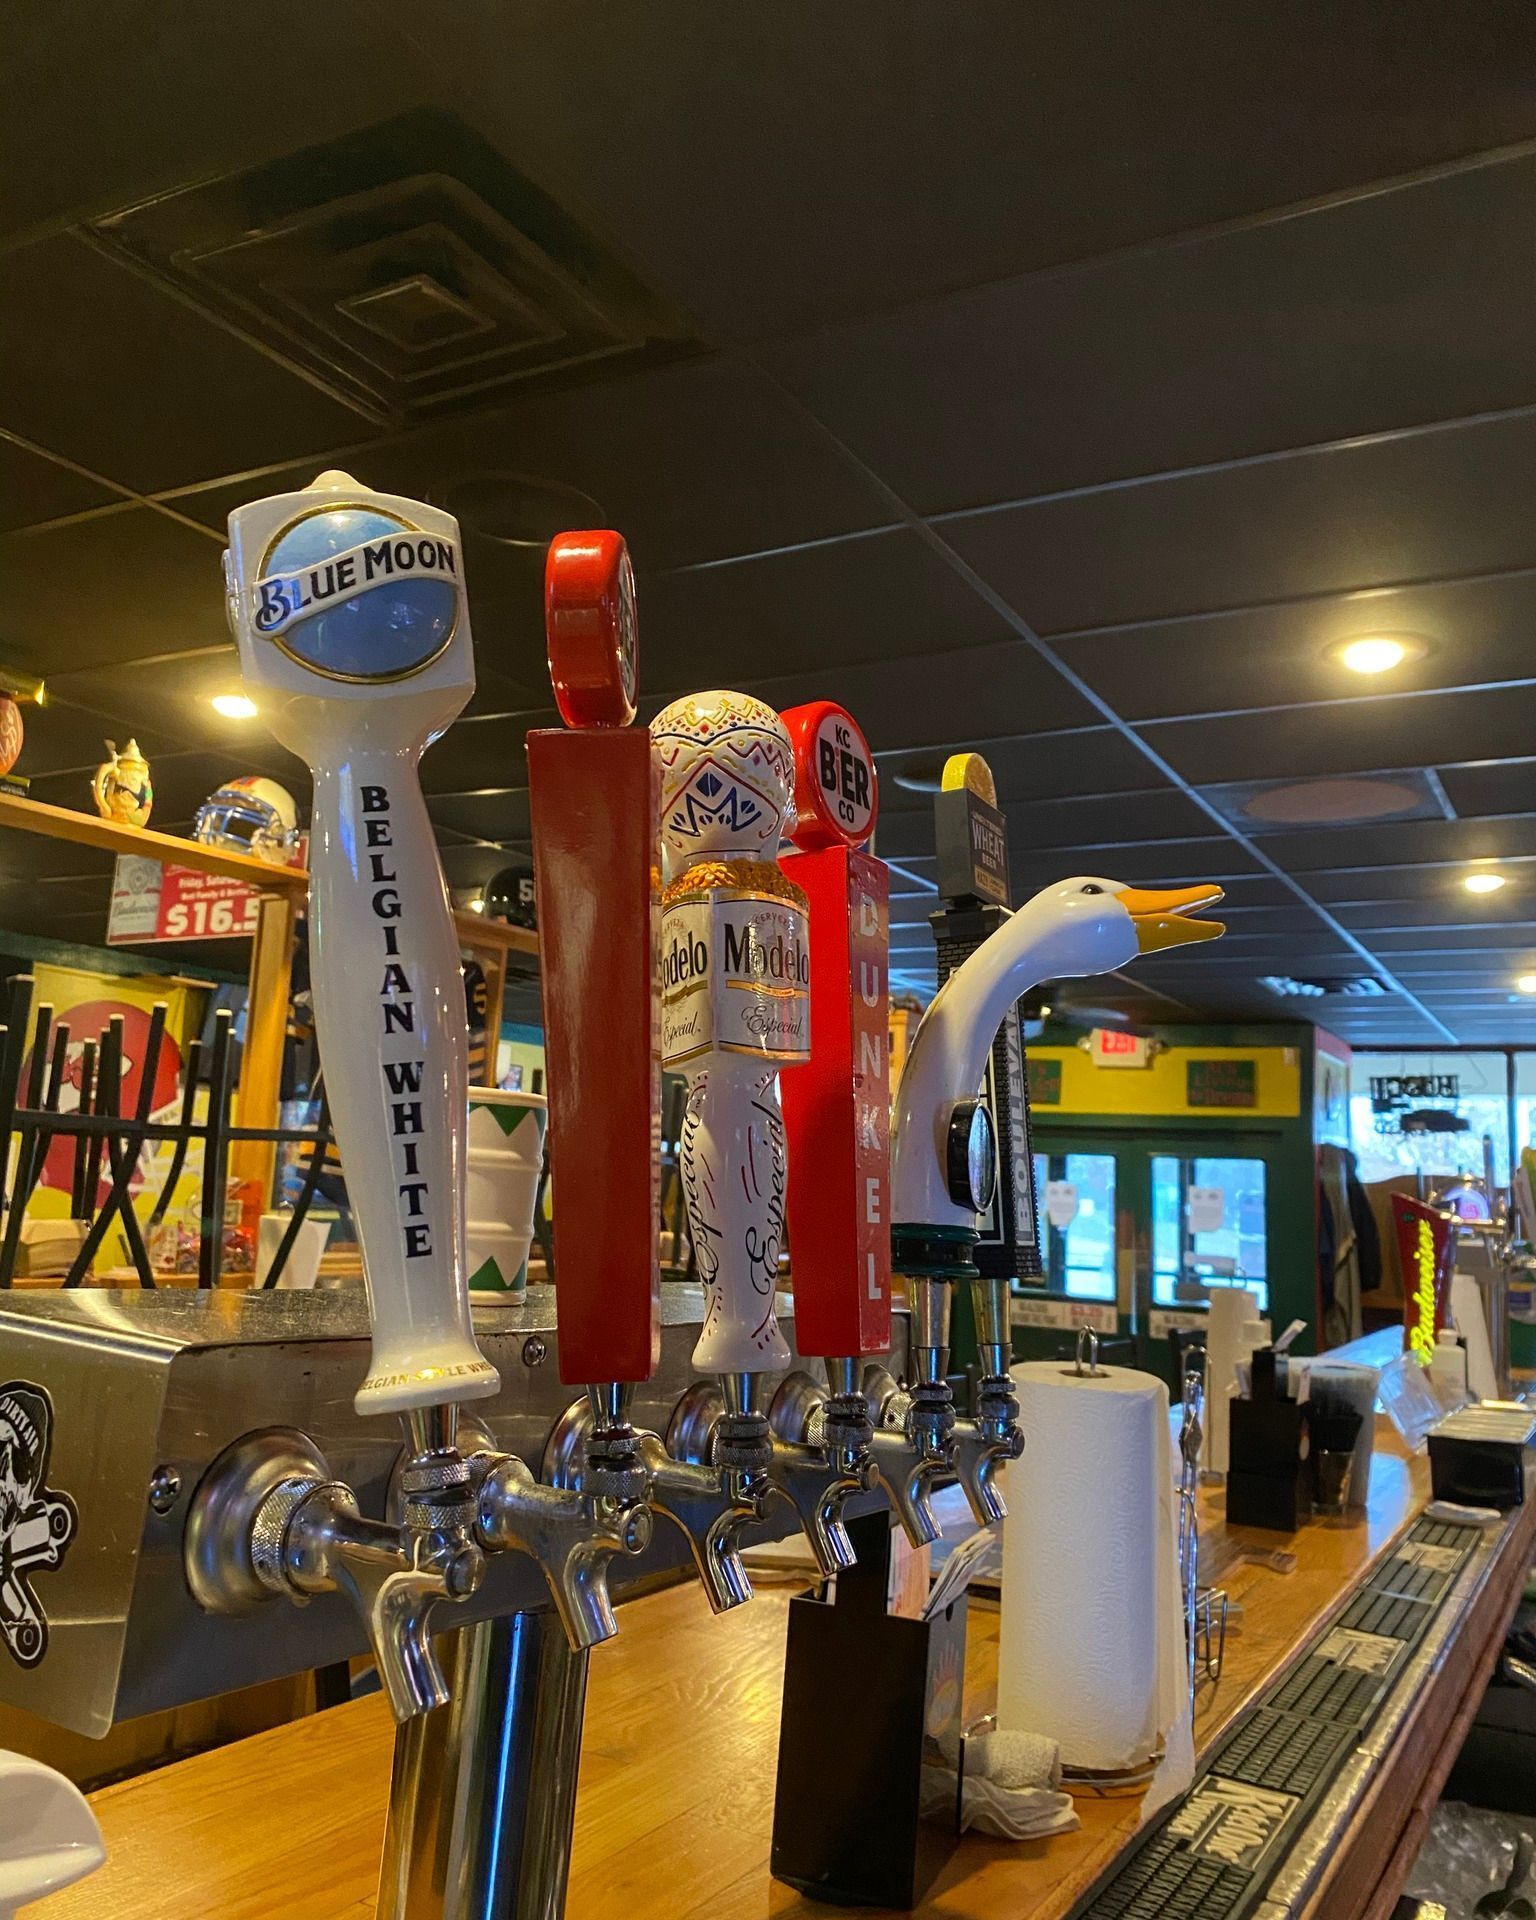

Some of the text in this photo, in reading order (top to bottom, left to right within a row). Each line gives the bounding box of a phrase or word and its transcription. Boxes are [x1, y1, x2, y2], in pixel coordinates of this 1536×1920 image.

[256, 540, 455, 631] BLUE MOON
[835, 724, 850, 748] KC
[838, 800, 854, 823] CO
[971, 819, 1004, 866] WHEAT
[755, 912, 795, 930] CERVEZ
[663, 930, 708, 990] odelo
[724, 923, 809, 984] Modelo
[360, 786, 432, 1258] BELGIAN WHITE
[740, 1006, 802, 1036] Especial
[859, 894, 881, 1300] DUNKEL
[680, 1110, 723, 1300] Especial
[746, 1100, 784, 1296] Especial
[1410, 1218, 1434, 1367] Budweiser
[0, 1397, 39, 1457] DIRTY AIR
